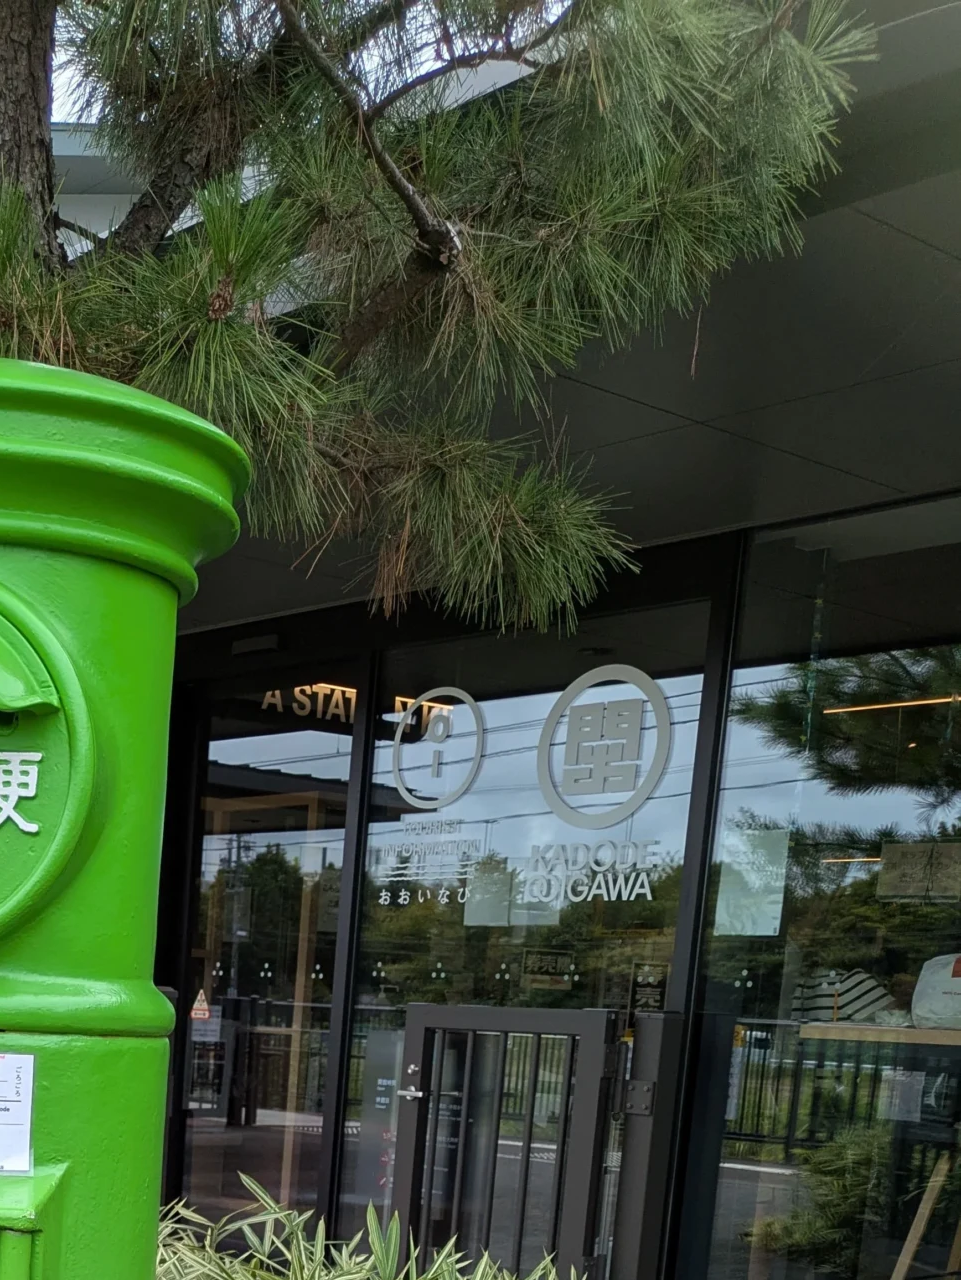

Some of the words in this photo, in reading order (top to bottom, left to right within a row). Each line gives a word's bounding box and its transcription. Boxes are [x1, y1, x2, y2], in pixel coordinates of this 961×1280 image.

[529, 840, 658, 872] KADODE
[378, 886, 473, 905] おおいなび
